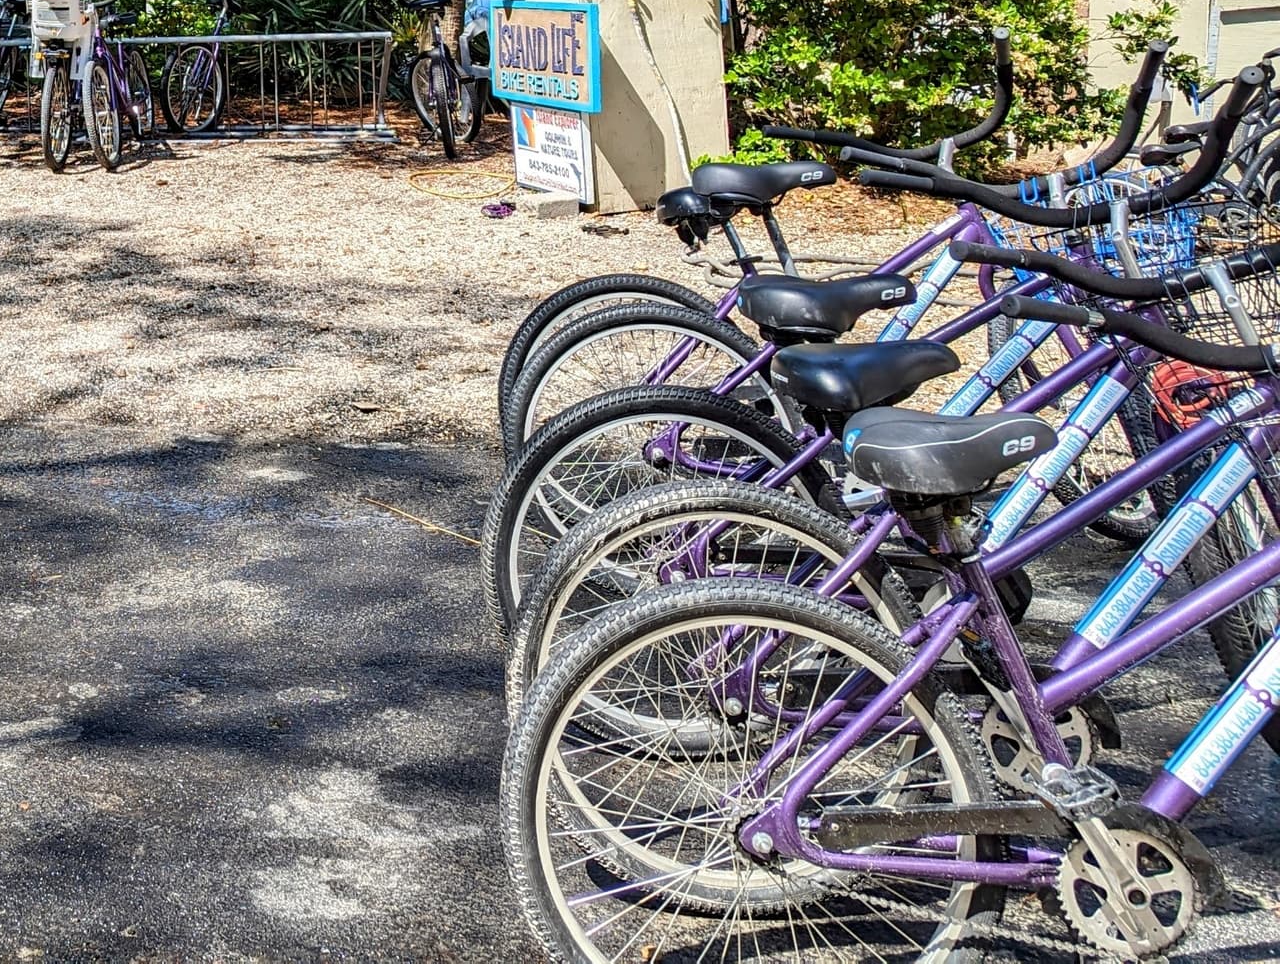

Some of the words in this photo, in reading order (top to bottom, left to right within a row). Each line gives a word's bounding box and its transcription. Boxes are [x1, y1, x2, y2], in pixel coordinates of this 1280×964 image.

[497, 12, 548, 72] ISLAND
[550, 12, 584, 76] LIFE
[500, 70, 525, 92] BIKE
[526, 74, 580, 100] RENTALS
[801, 170, 823, 182] C9
[881, 286, 906, 300] C9
[984, 349, 1016, 381] ISLAND
[1005, 335, 1029, 360] LIFE
[1081, 408, 1100, 429] BIKE
[1092, 381, 1122, 413] RENTALS
[1003, 435, 1036, 457] C9
[1036, 444, 1074, 484] ISLAND
[1057, 427, 1086, 456] LIFE
[986, 483, 1041, 544] 843.384.1430
[1206, 481, 1229, 505] BIKE
[1151, 521, 1197, 569] ISLAND
[1177, 500, 1212, 535] LIFE
[1093, 567, 1157, 639] 843.384.1430
[1190, 697, 1263, 779] 843.384.1430
